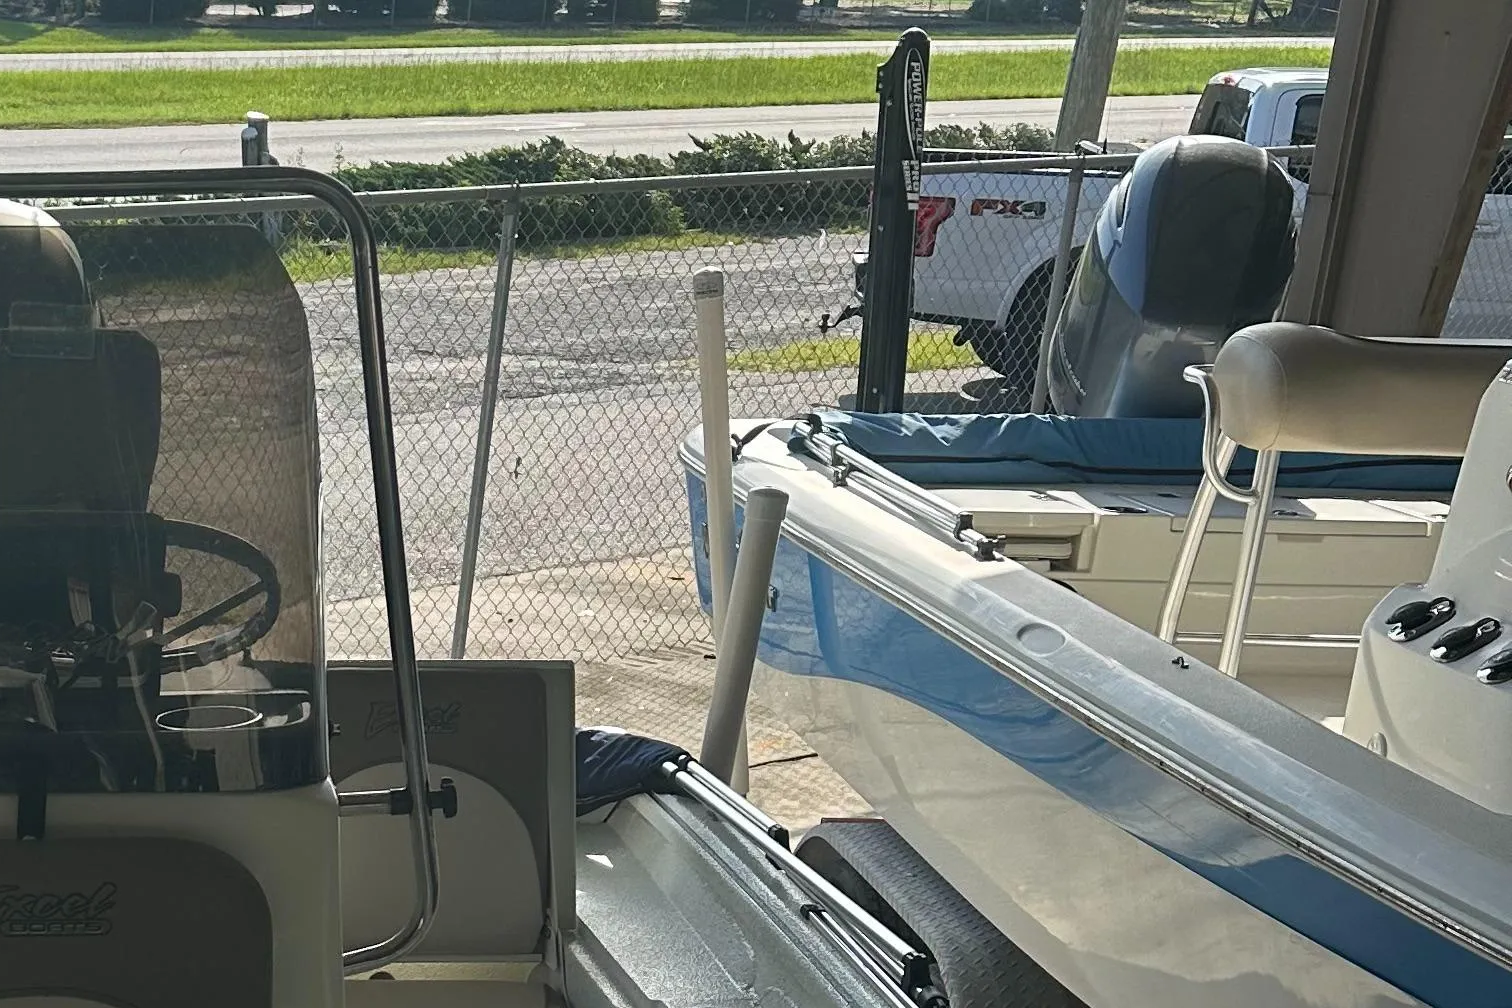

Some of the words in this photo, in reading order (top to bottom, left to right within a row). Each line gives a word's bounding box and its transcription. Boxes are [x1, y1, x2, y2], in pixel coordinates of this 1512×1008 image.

[910, 61, 925, 154] POWER-POLE
[910, 159, 920, 192] PRO
[971, 199, 1047, 216] FX4
[363, 698, 466, 741] Eel
[9, 920, 102, 936] BOATS
